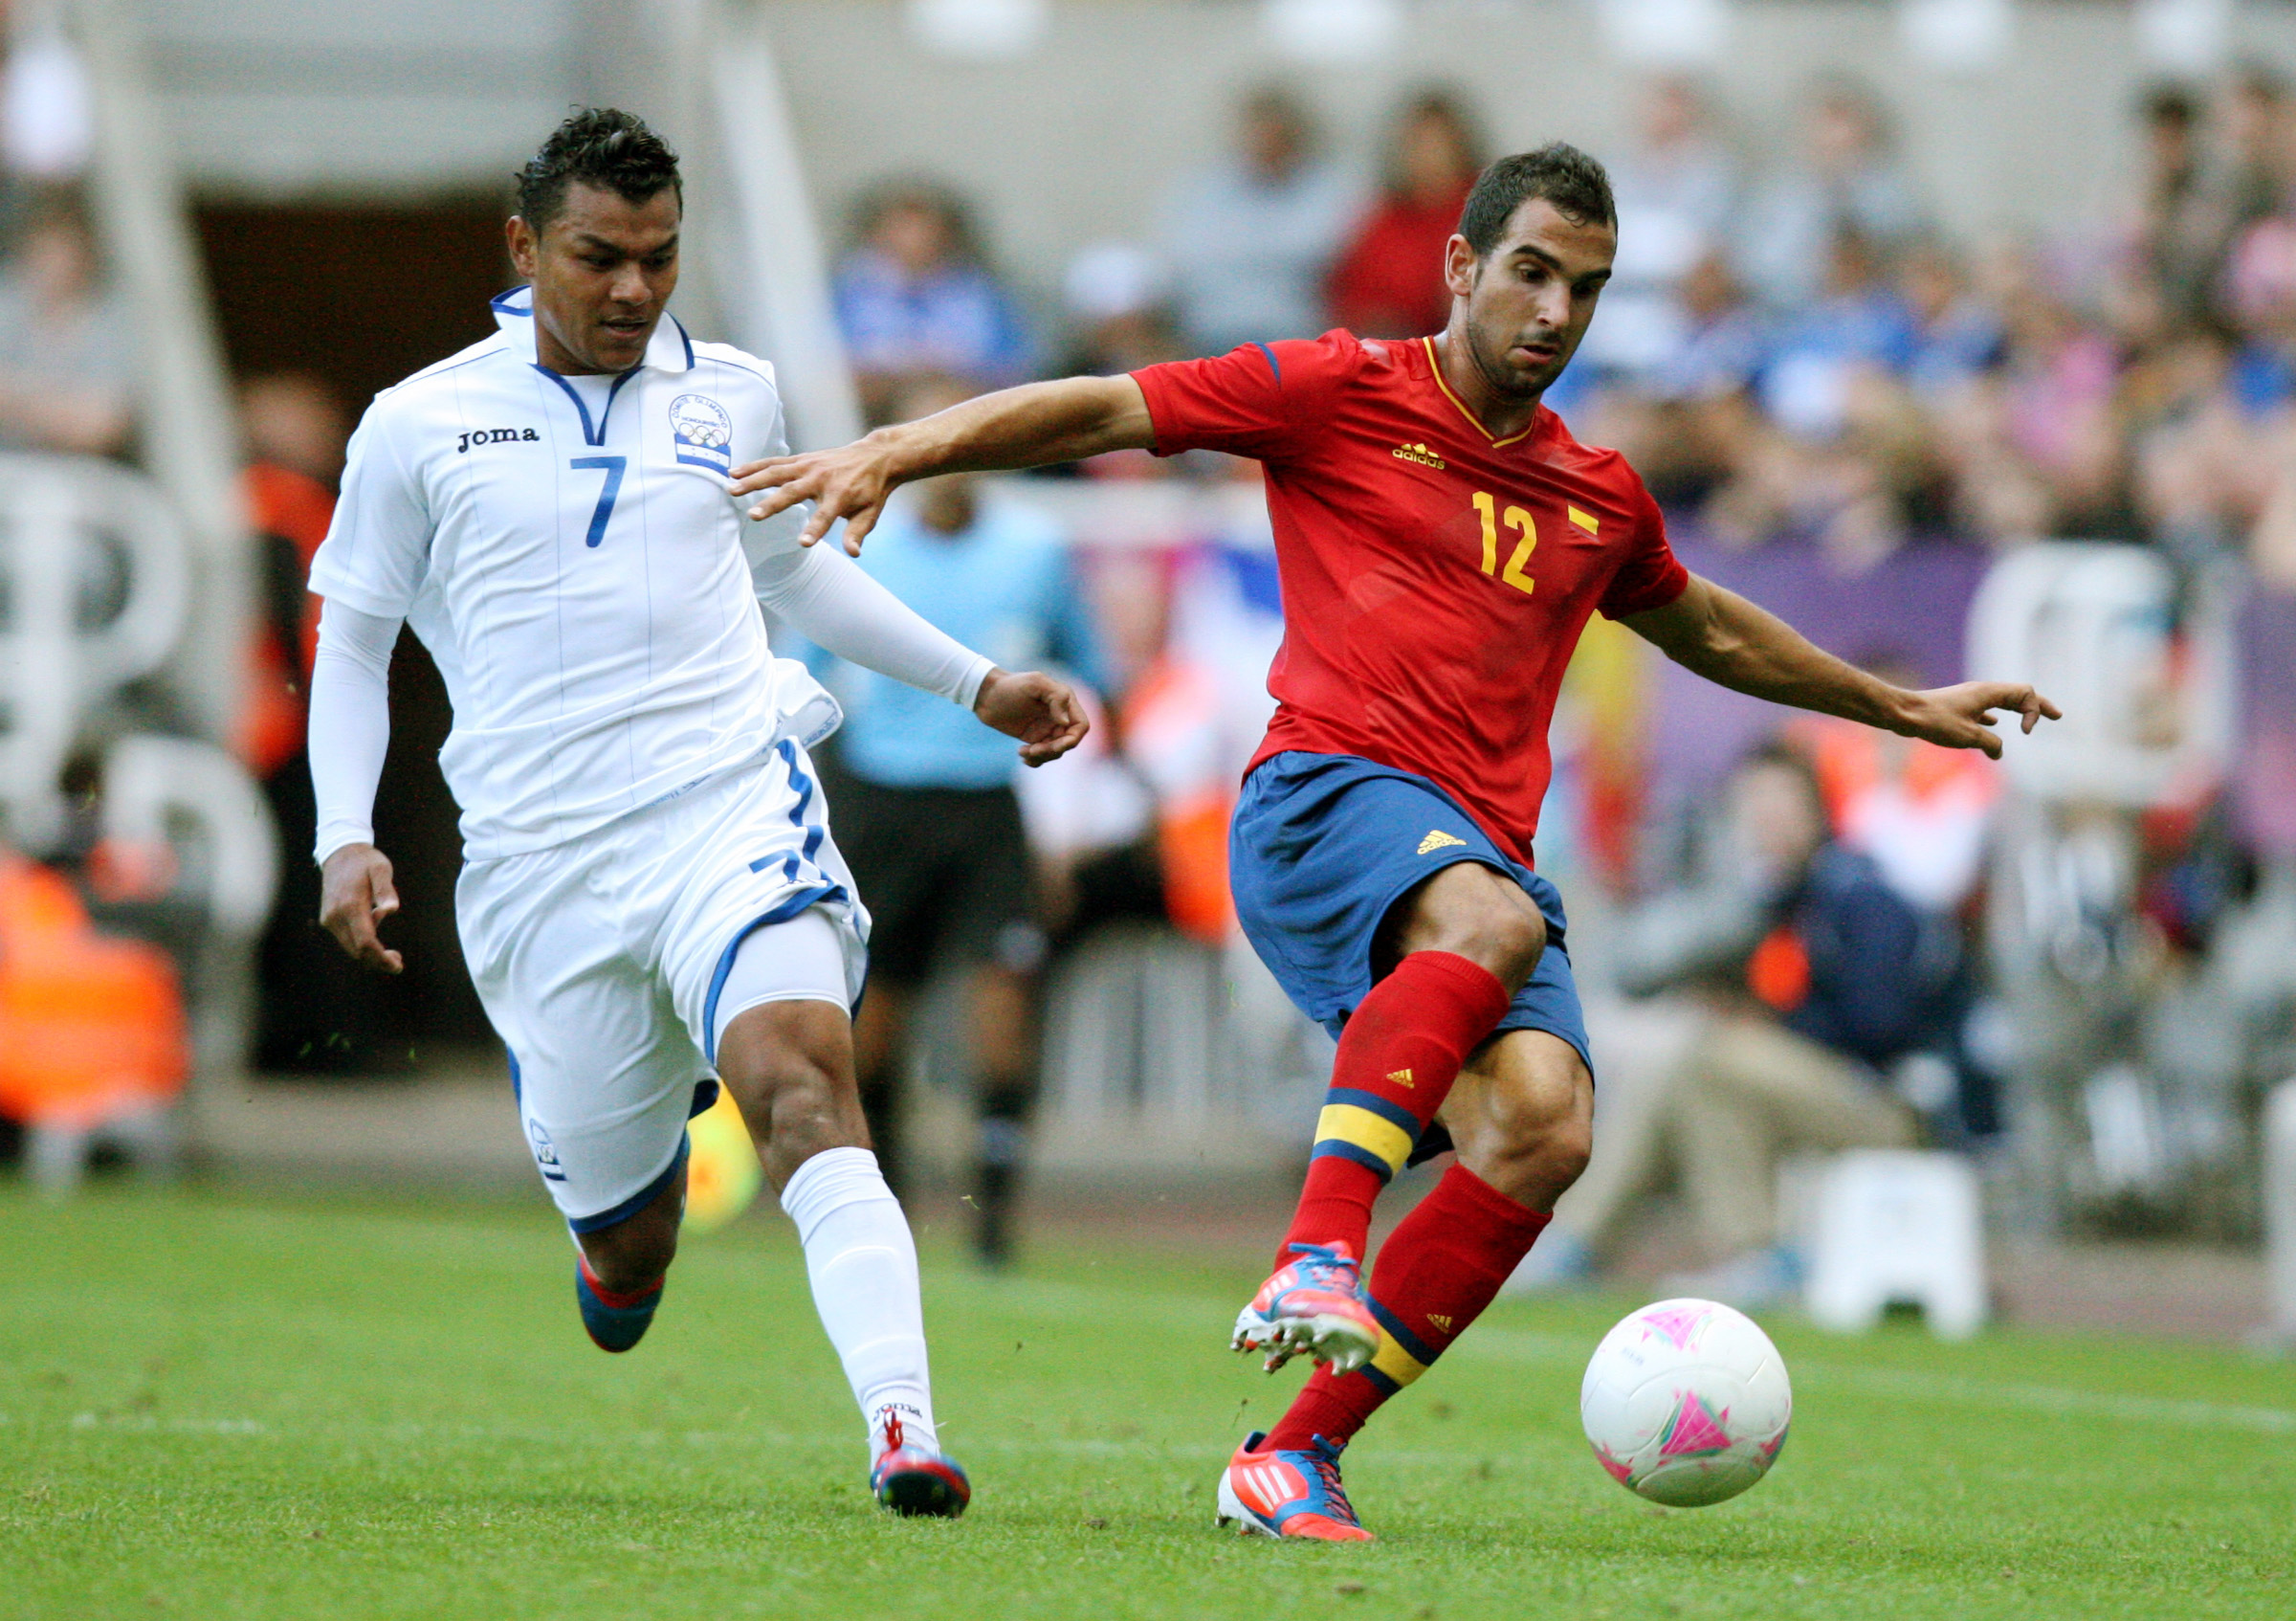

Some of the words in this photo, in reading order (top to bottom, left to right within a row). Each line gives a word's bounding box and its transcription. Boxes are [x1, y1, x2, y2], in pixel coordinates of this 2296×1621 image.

[457, 428, 541, 454] joma
[1392, 449, 1446, 470] adidas
[570, 455, 628, 548] 7
[1472, 490, 1537, 595] 12
